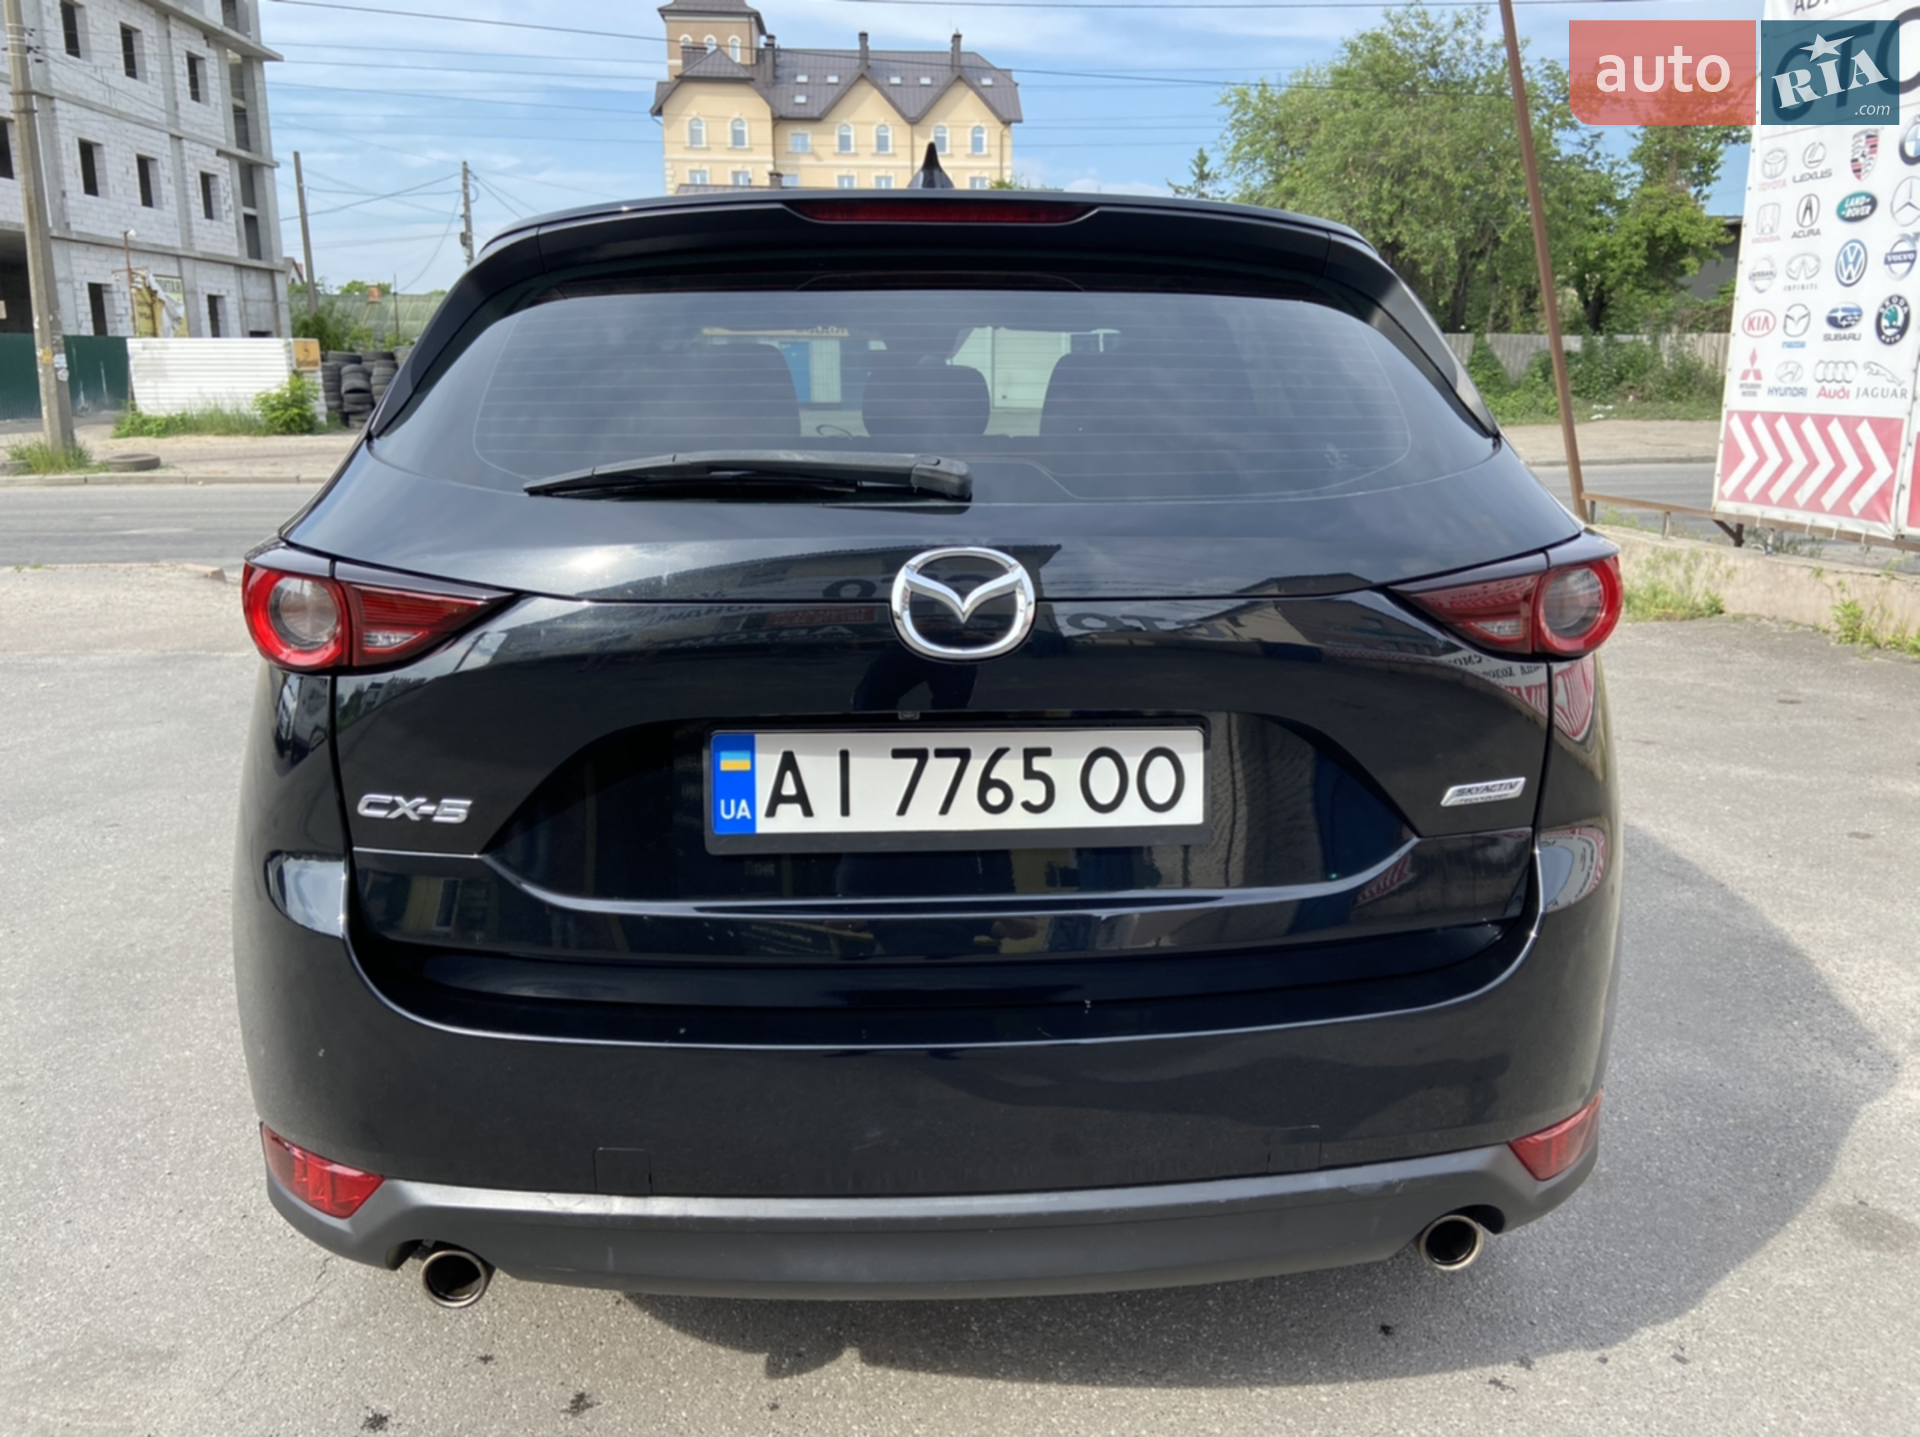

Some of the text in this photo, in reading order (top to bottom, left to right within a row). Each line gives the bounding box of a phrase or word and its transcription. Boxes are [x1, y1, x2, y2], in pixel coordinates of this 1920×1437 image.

[1792, 168, 1833, 184] LEXUS
[1791, 228, 1821, 239] ACURA
[1886, 253, 1915, 262] VOLVO
[1747, 315, 1770, 331] KIA
[1823, 332, 1862, 342] SUBARU
[1767, 386, 1808, 397] HYUNDAI
[1816, 385, 1850, 400] Audi
[1855, 387, 1908, 399] JAGUAR
[764, 746, 1185, 818] AI 7765 OO
[1455, 780, 1521, 797] SKYACTIV
[357, 793, 473, 824] CX-5
[719, 799, 752, 820] UA
